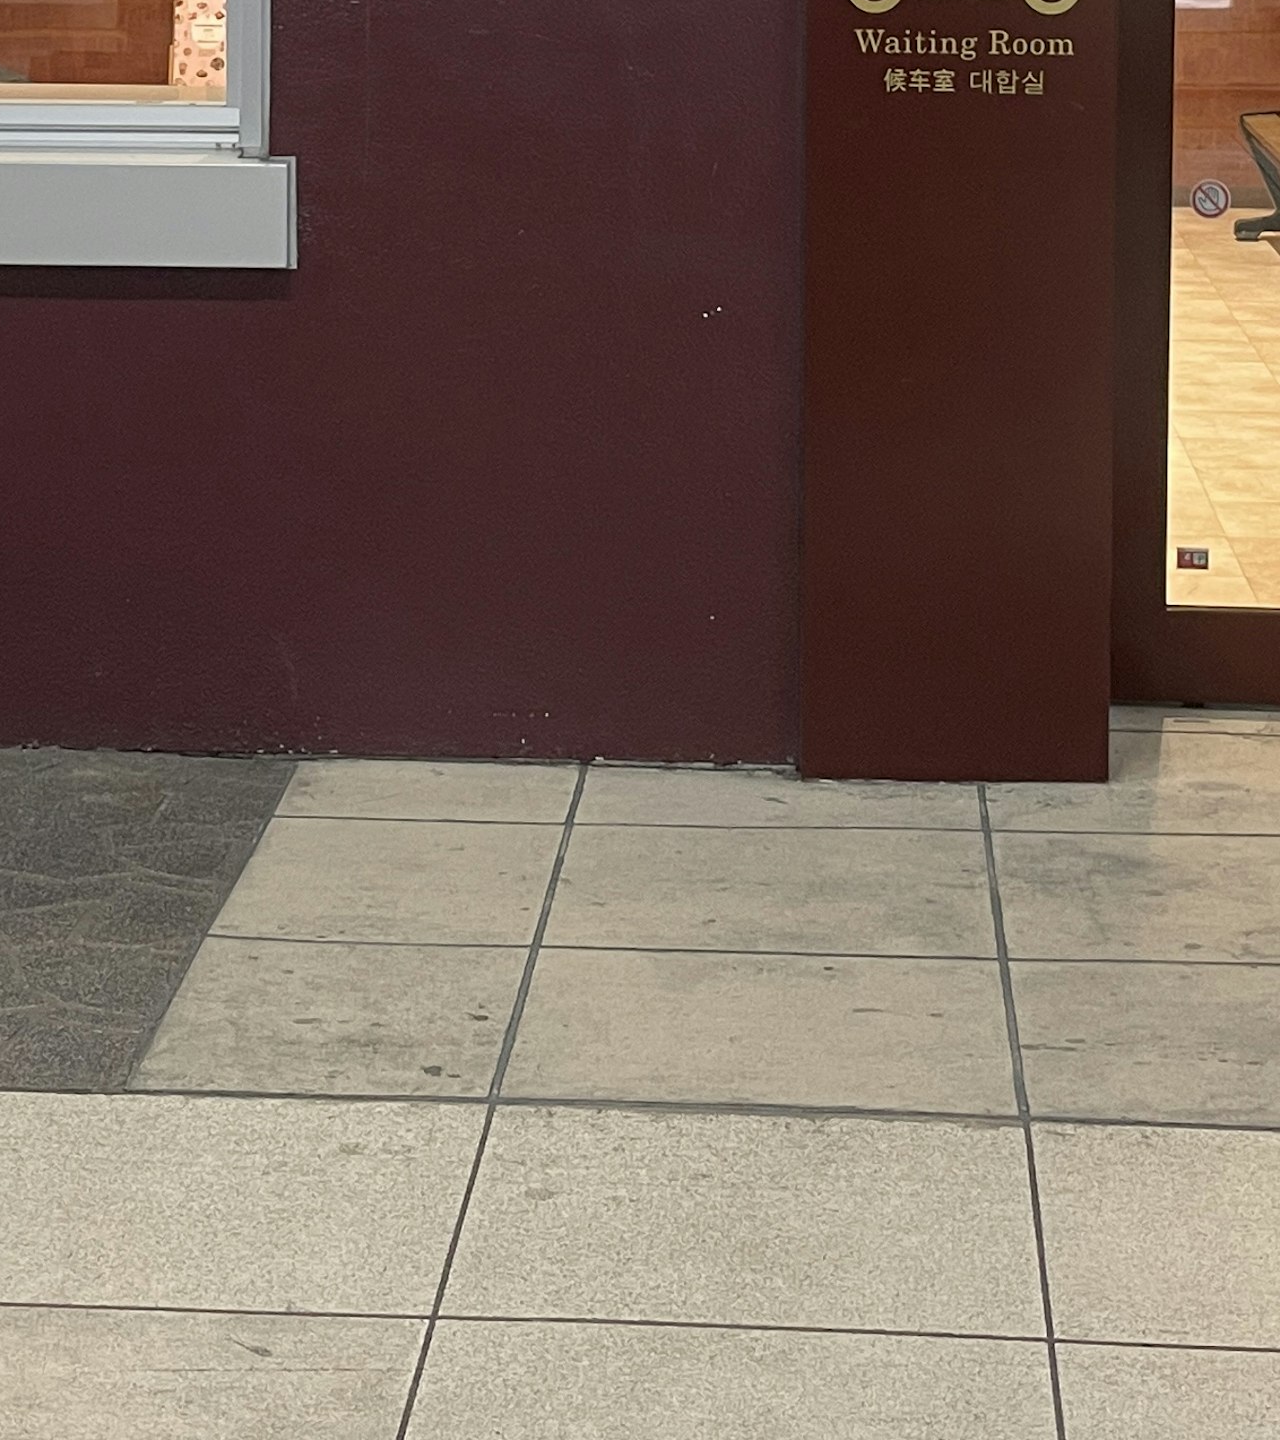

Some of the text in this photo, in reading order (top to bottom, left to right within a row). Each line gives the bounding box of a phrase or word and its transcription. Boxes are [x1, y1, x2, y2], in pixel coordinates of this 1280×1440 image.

[853, 28, 1075, 61] Waiting Room
[883, 67, 1045, 95] 候车室 대합실
